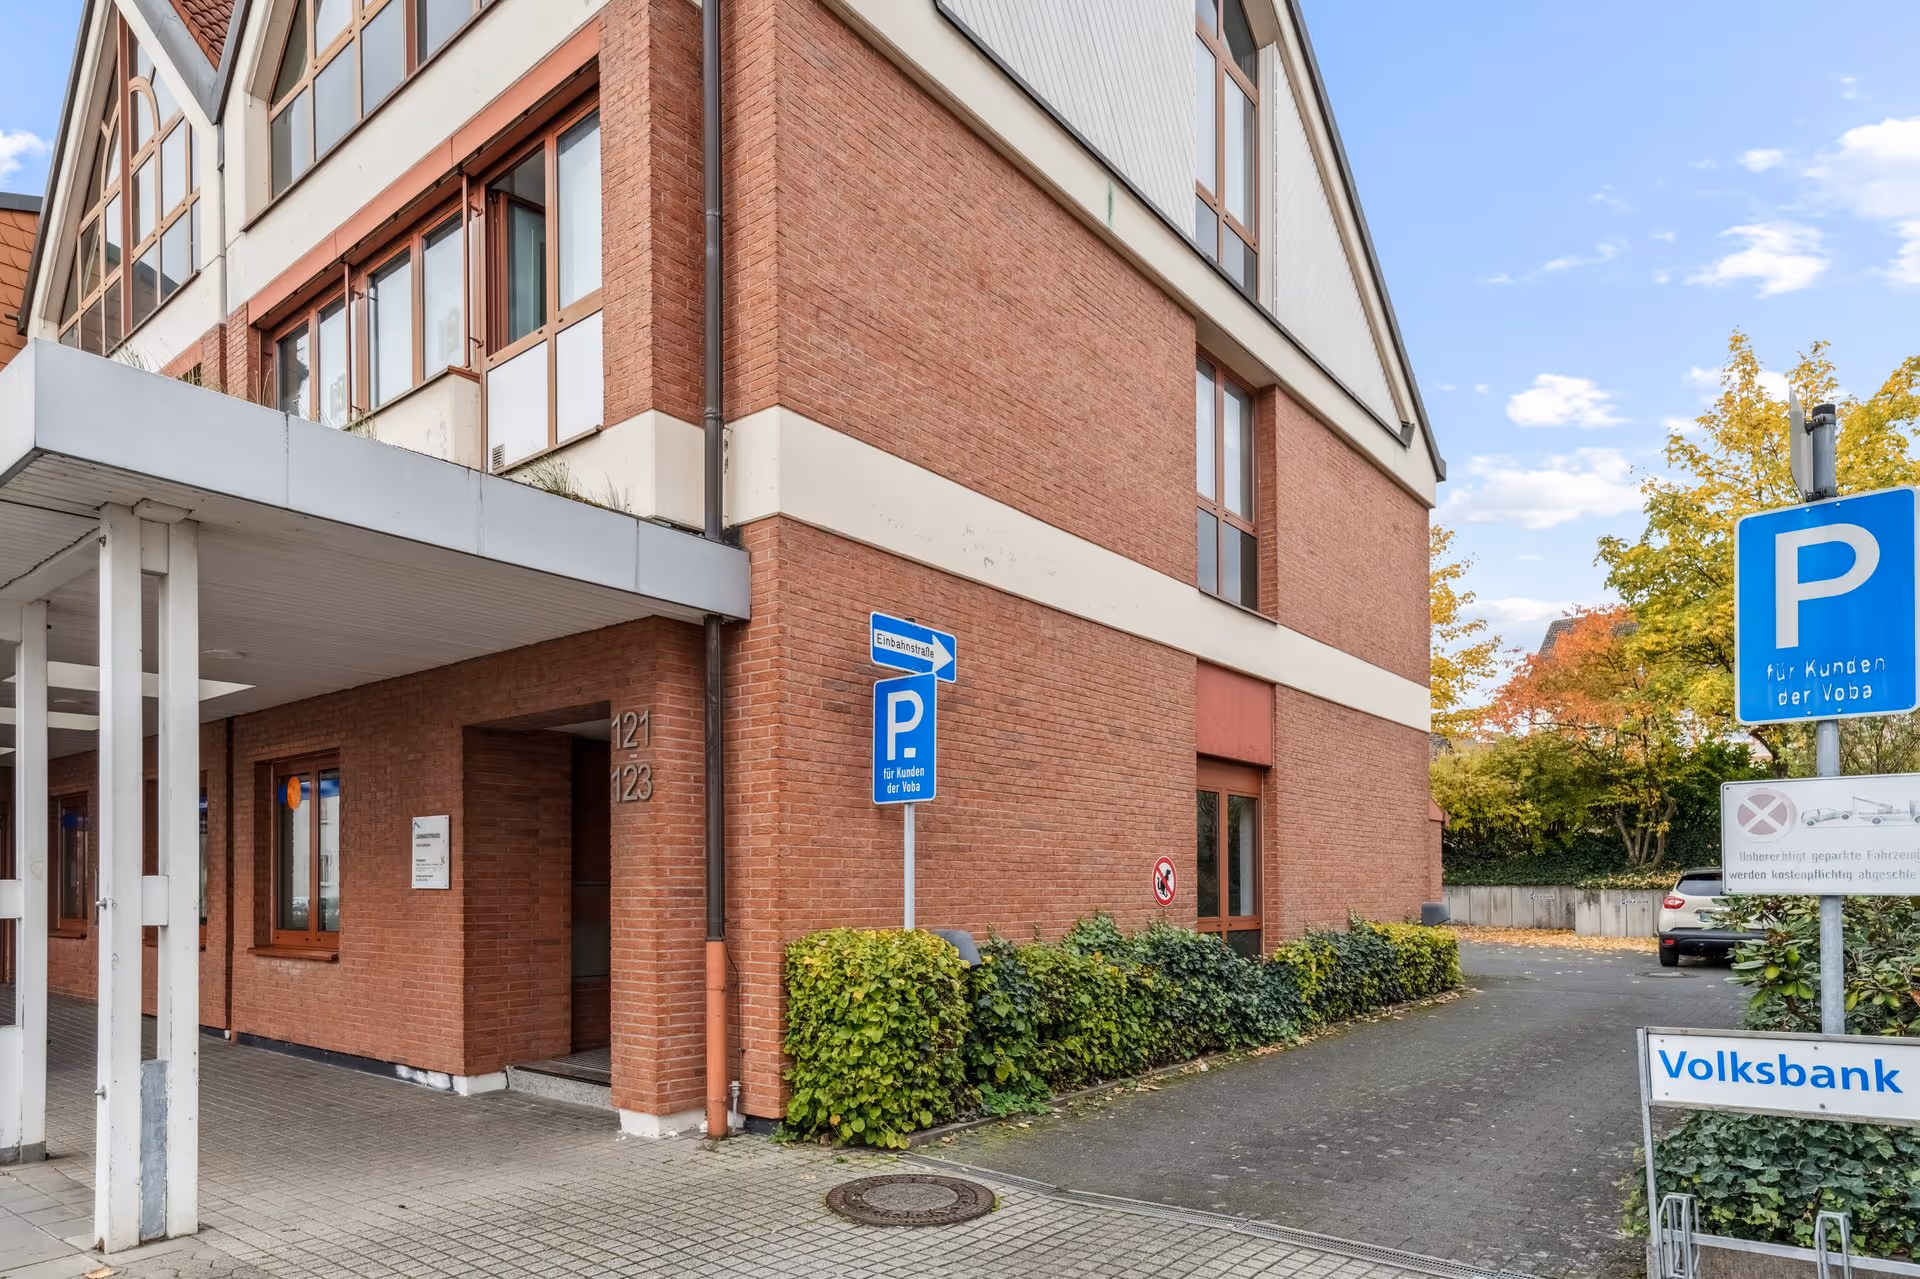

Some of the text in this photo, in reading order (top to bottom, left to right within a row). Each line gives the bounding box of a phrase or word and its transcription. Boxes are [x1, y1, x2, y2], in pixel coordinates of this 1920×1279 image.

[1775, 523, 1881, 649] P
[876, 632, 935, 659] Einbahnstraße
[1766, 656, 1886, 682] für Kunden
[1778, 680, 1873, 706] der Voba
[611, 709, 650, 749] 121
[610, 762, 653, 802] 123
[883, 765, 925, 780] für Kunden
[887, 780, 921, 794] der Voba
[1738, 850, 1807, 865] Unberechtigt
[1811, 850, 1862, 864] geparkte
[1728, 868, 1767, 880] werden
[1771, 868, 1853, 882] kostenpflichtig
[1658, 1049, 1904, 1094] Volksbank
